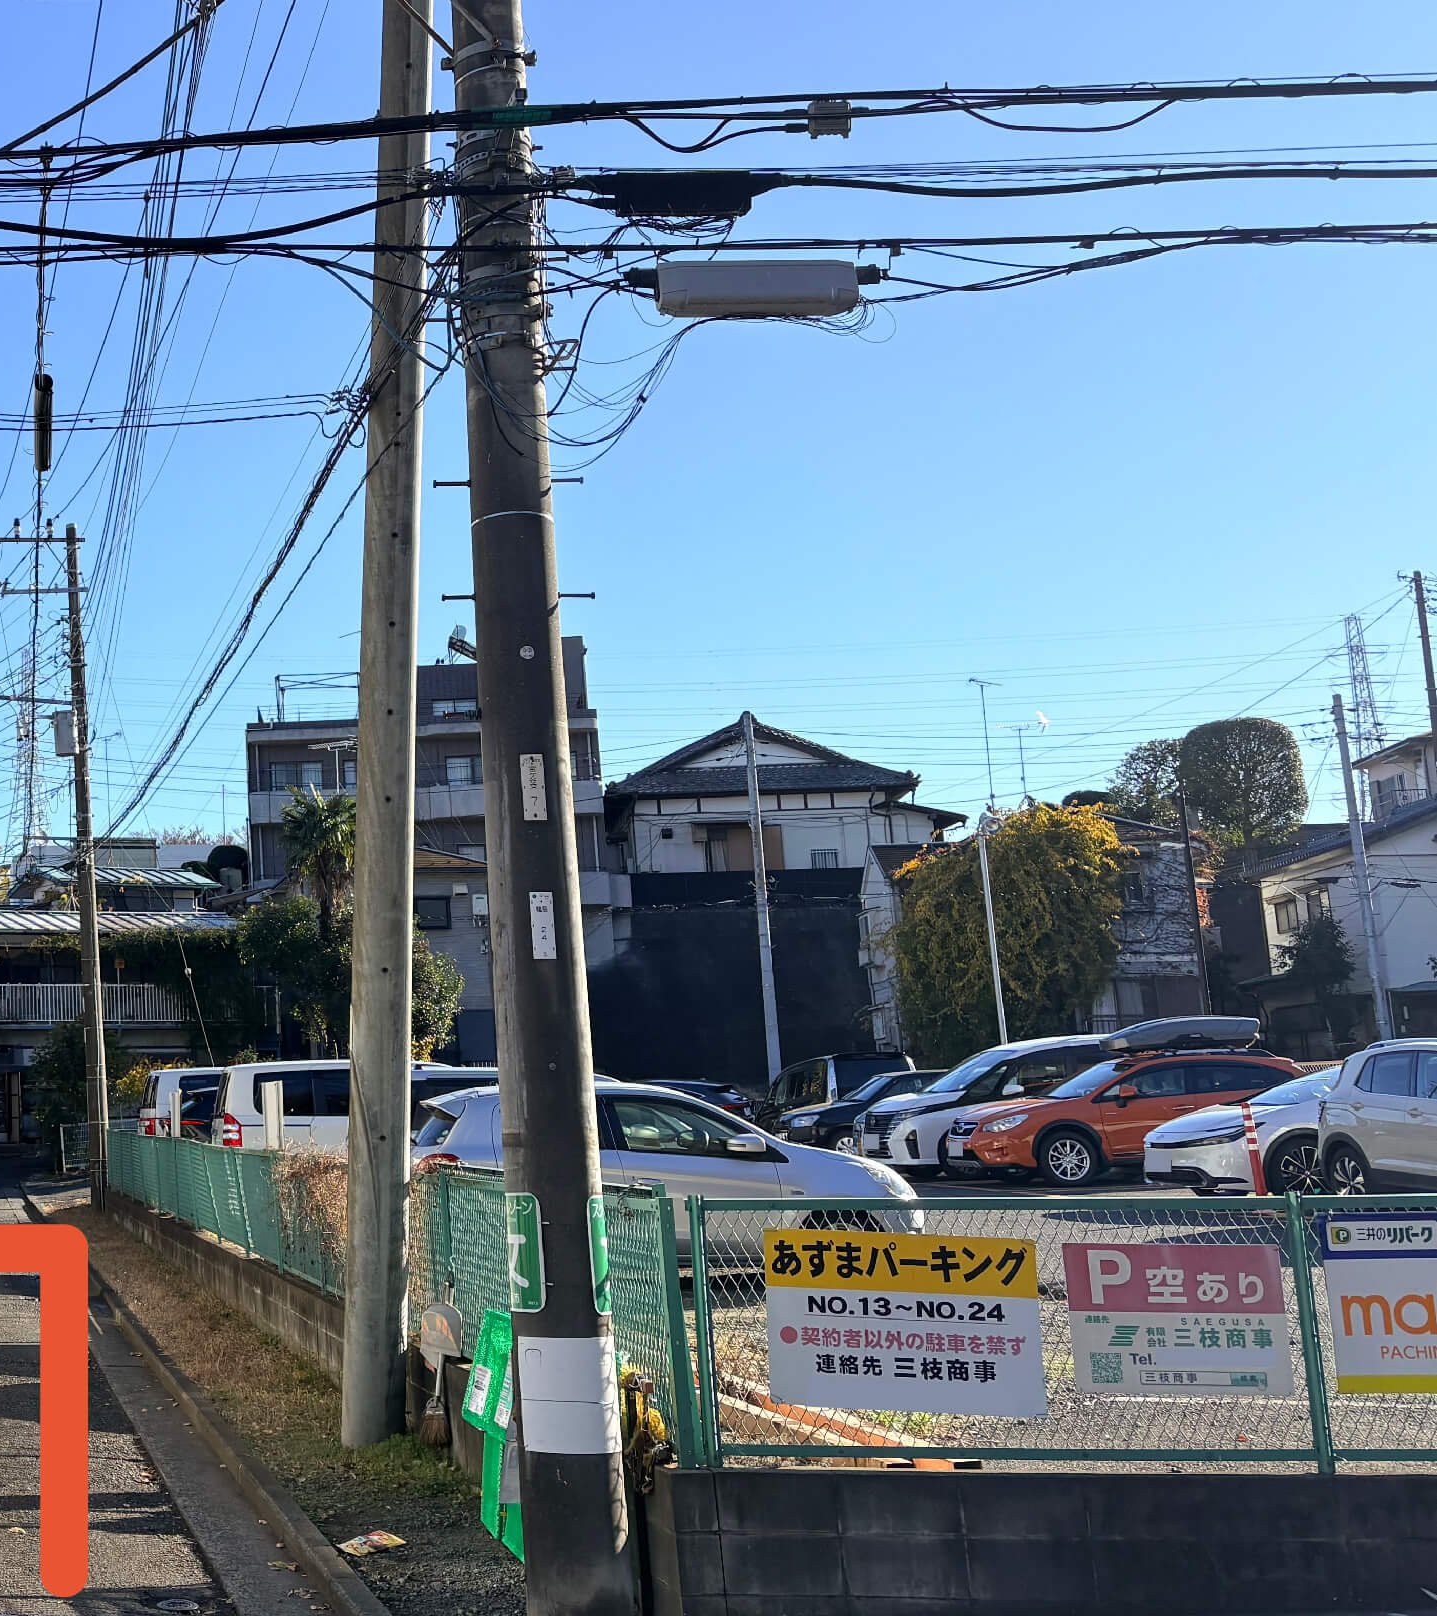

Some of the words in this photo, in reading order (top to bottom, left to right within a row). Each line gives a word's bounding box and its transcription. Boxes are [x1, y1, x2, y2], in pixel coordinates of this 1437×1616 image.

[1356, 1225, 1433, 1243] 三井のリパーク
[771, 1240, 1028, 1287] あずまパーキング
[1086, 1249, 1132, 1305] P
[1145, 1266, 1265, 1304] 空あり
[1180, 1317, 1266, 1327] SAEGUSA
[801, 1326, 1026, 1356] 契約者以外の駐車を禁ず
[1173, 1328, 1274, 1349] 三枝商事
[815, 1353, 883, 1377] 連絡先
[894, 1356, 997, 1383] 三枝商事
[1129, 1353, 1157, 1366] Tel.
[1144, 1372, 1198, 1384] 三枝商事
